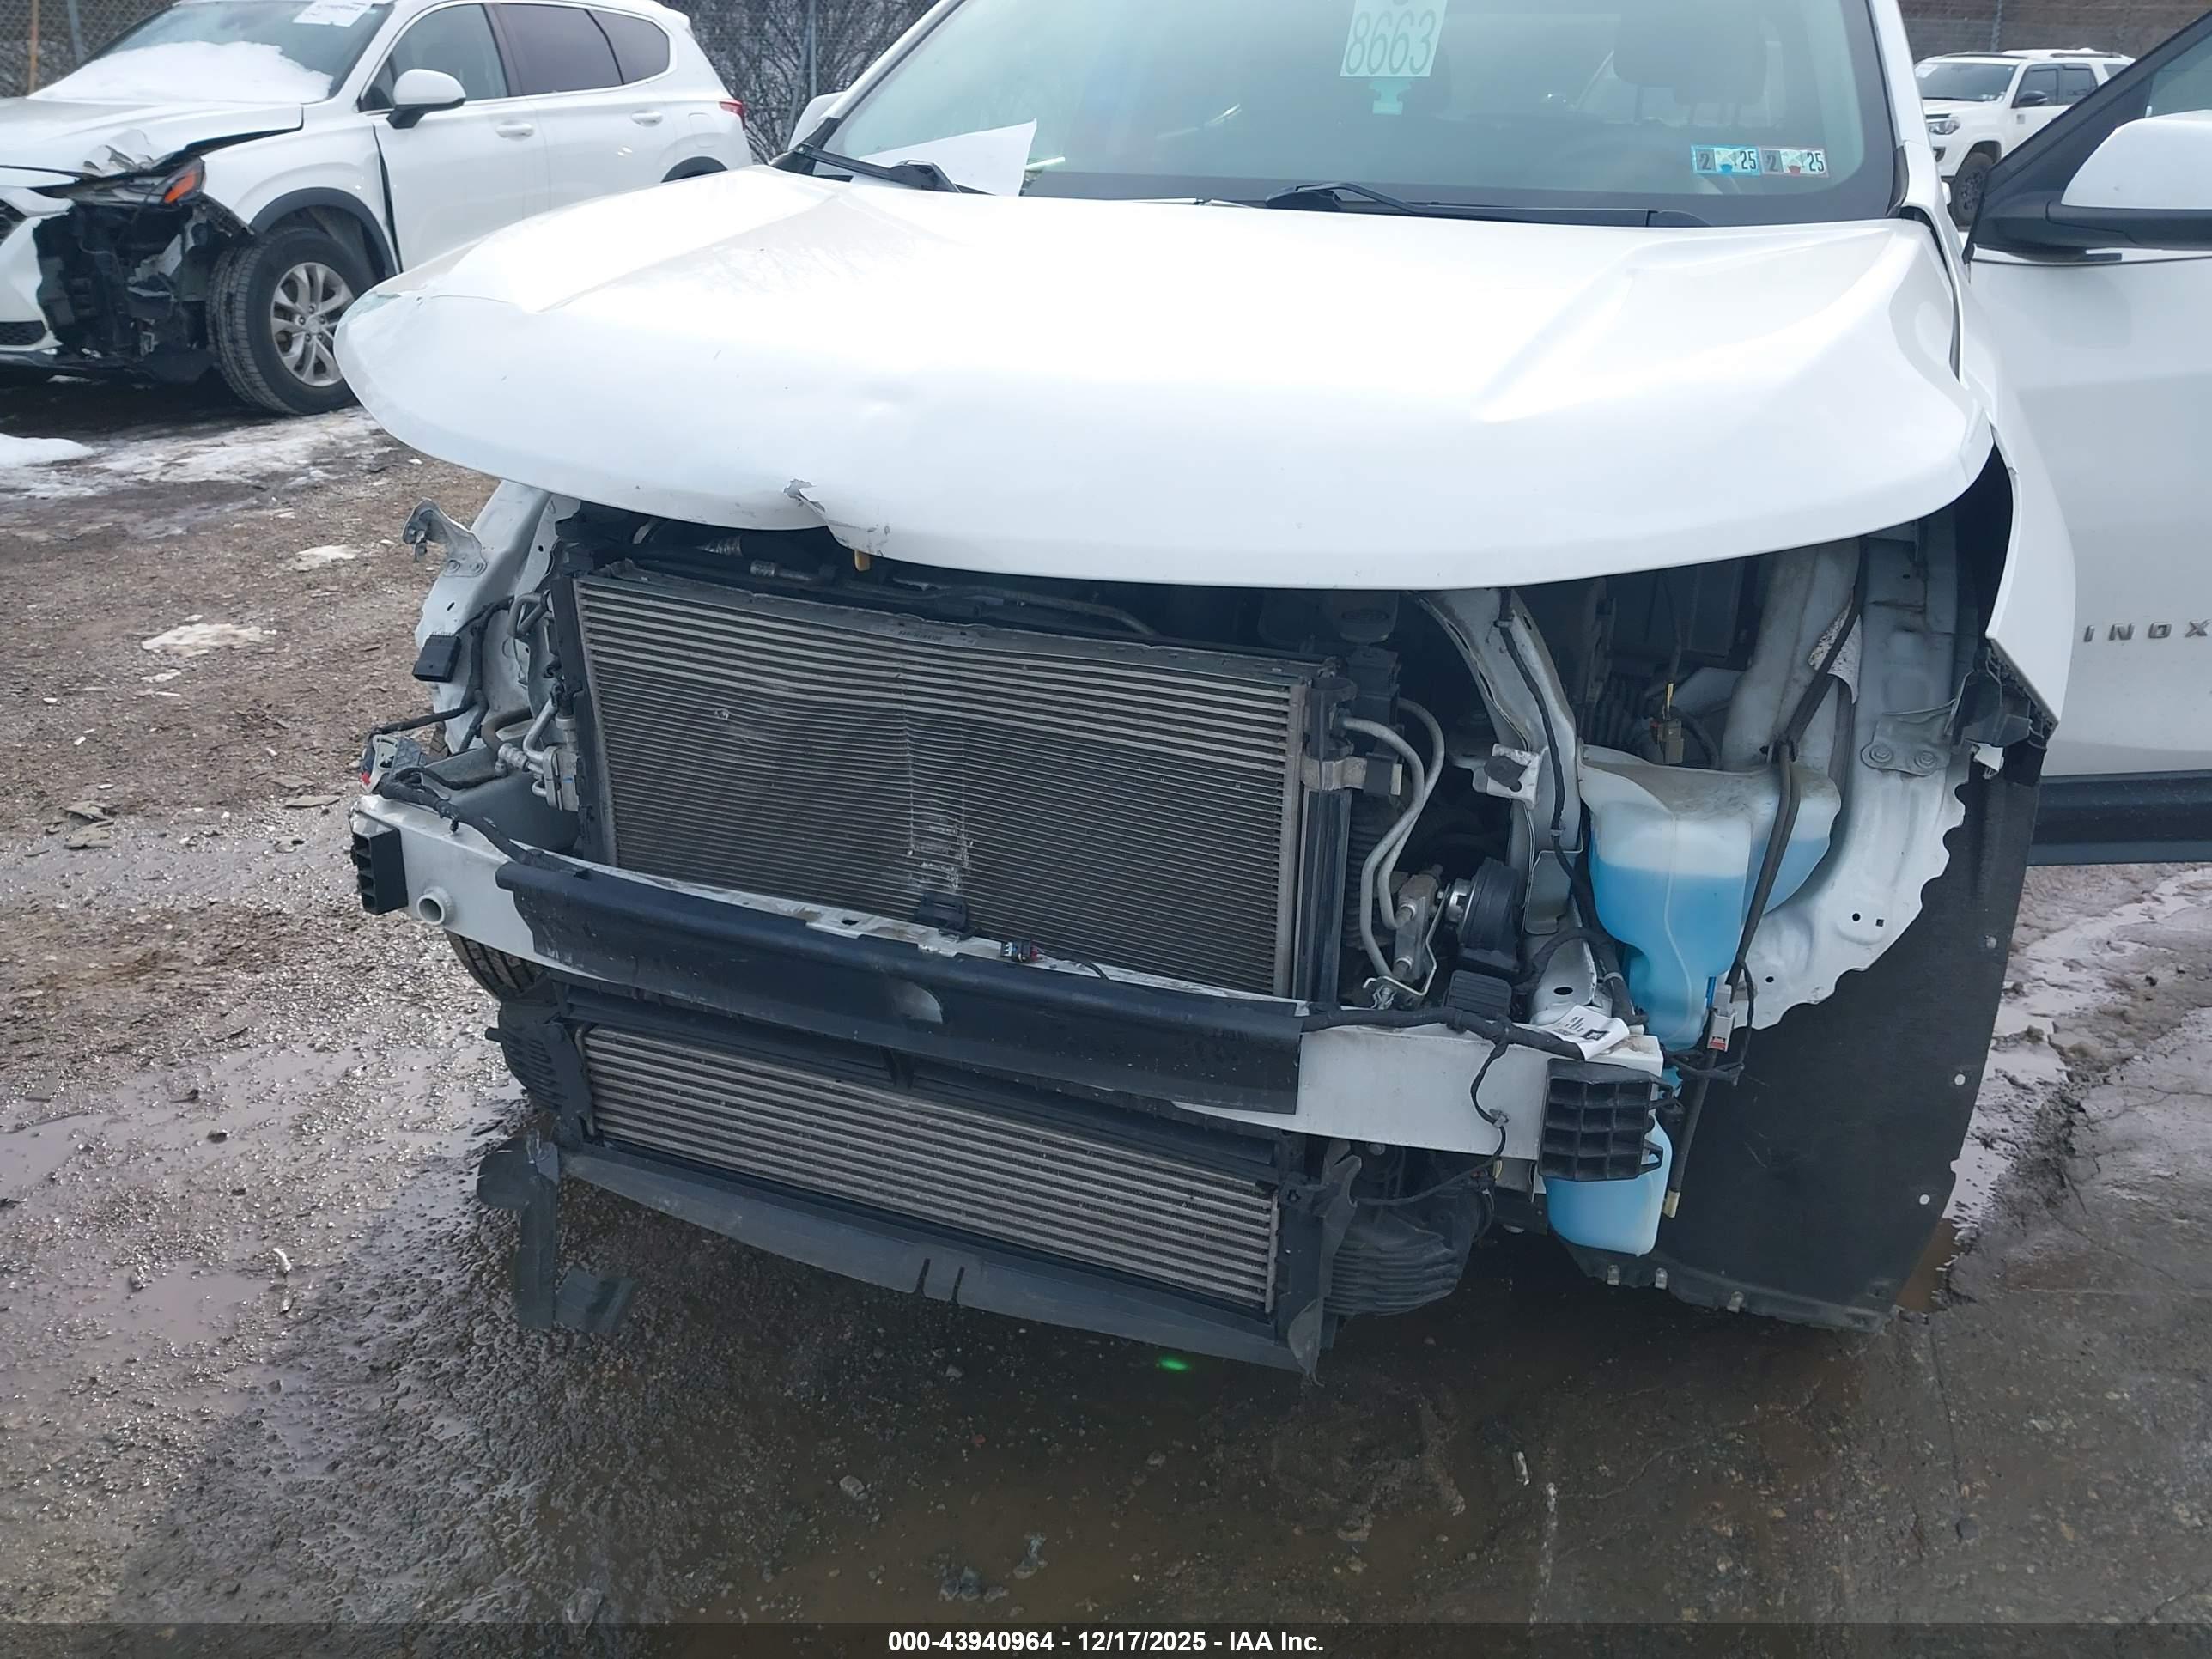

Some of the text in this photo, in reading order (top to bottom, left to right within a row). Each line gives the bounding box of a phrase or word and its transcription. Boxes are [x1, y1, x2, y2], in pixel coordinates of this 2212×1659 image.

[1346, 9, 1437, 75] 8663
[1699, 150, 1757, 170] 2 25
[1807, 152, 1825, 172] 25
